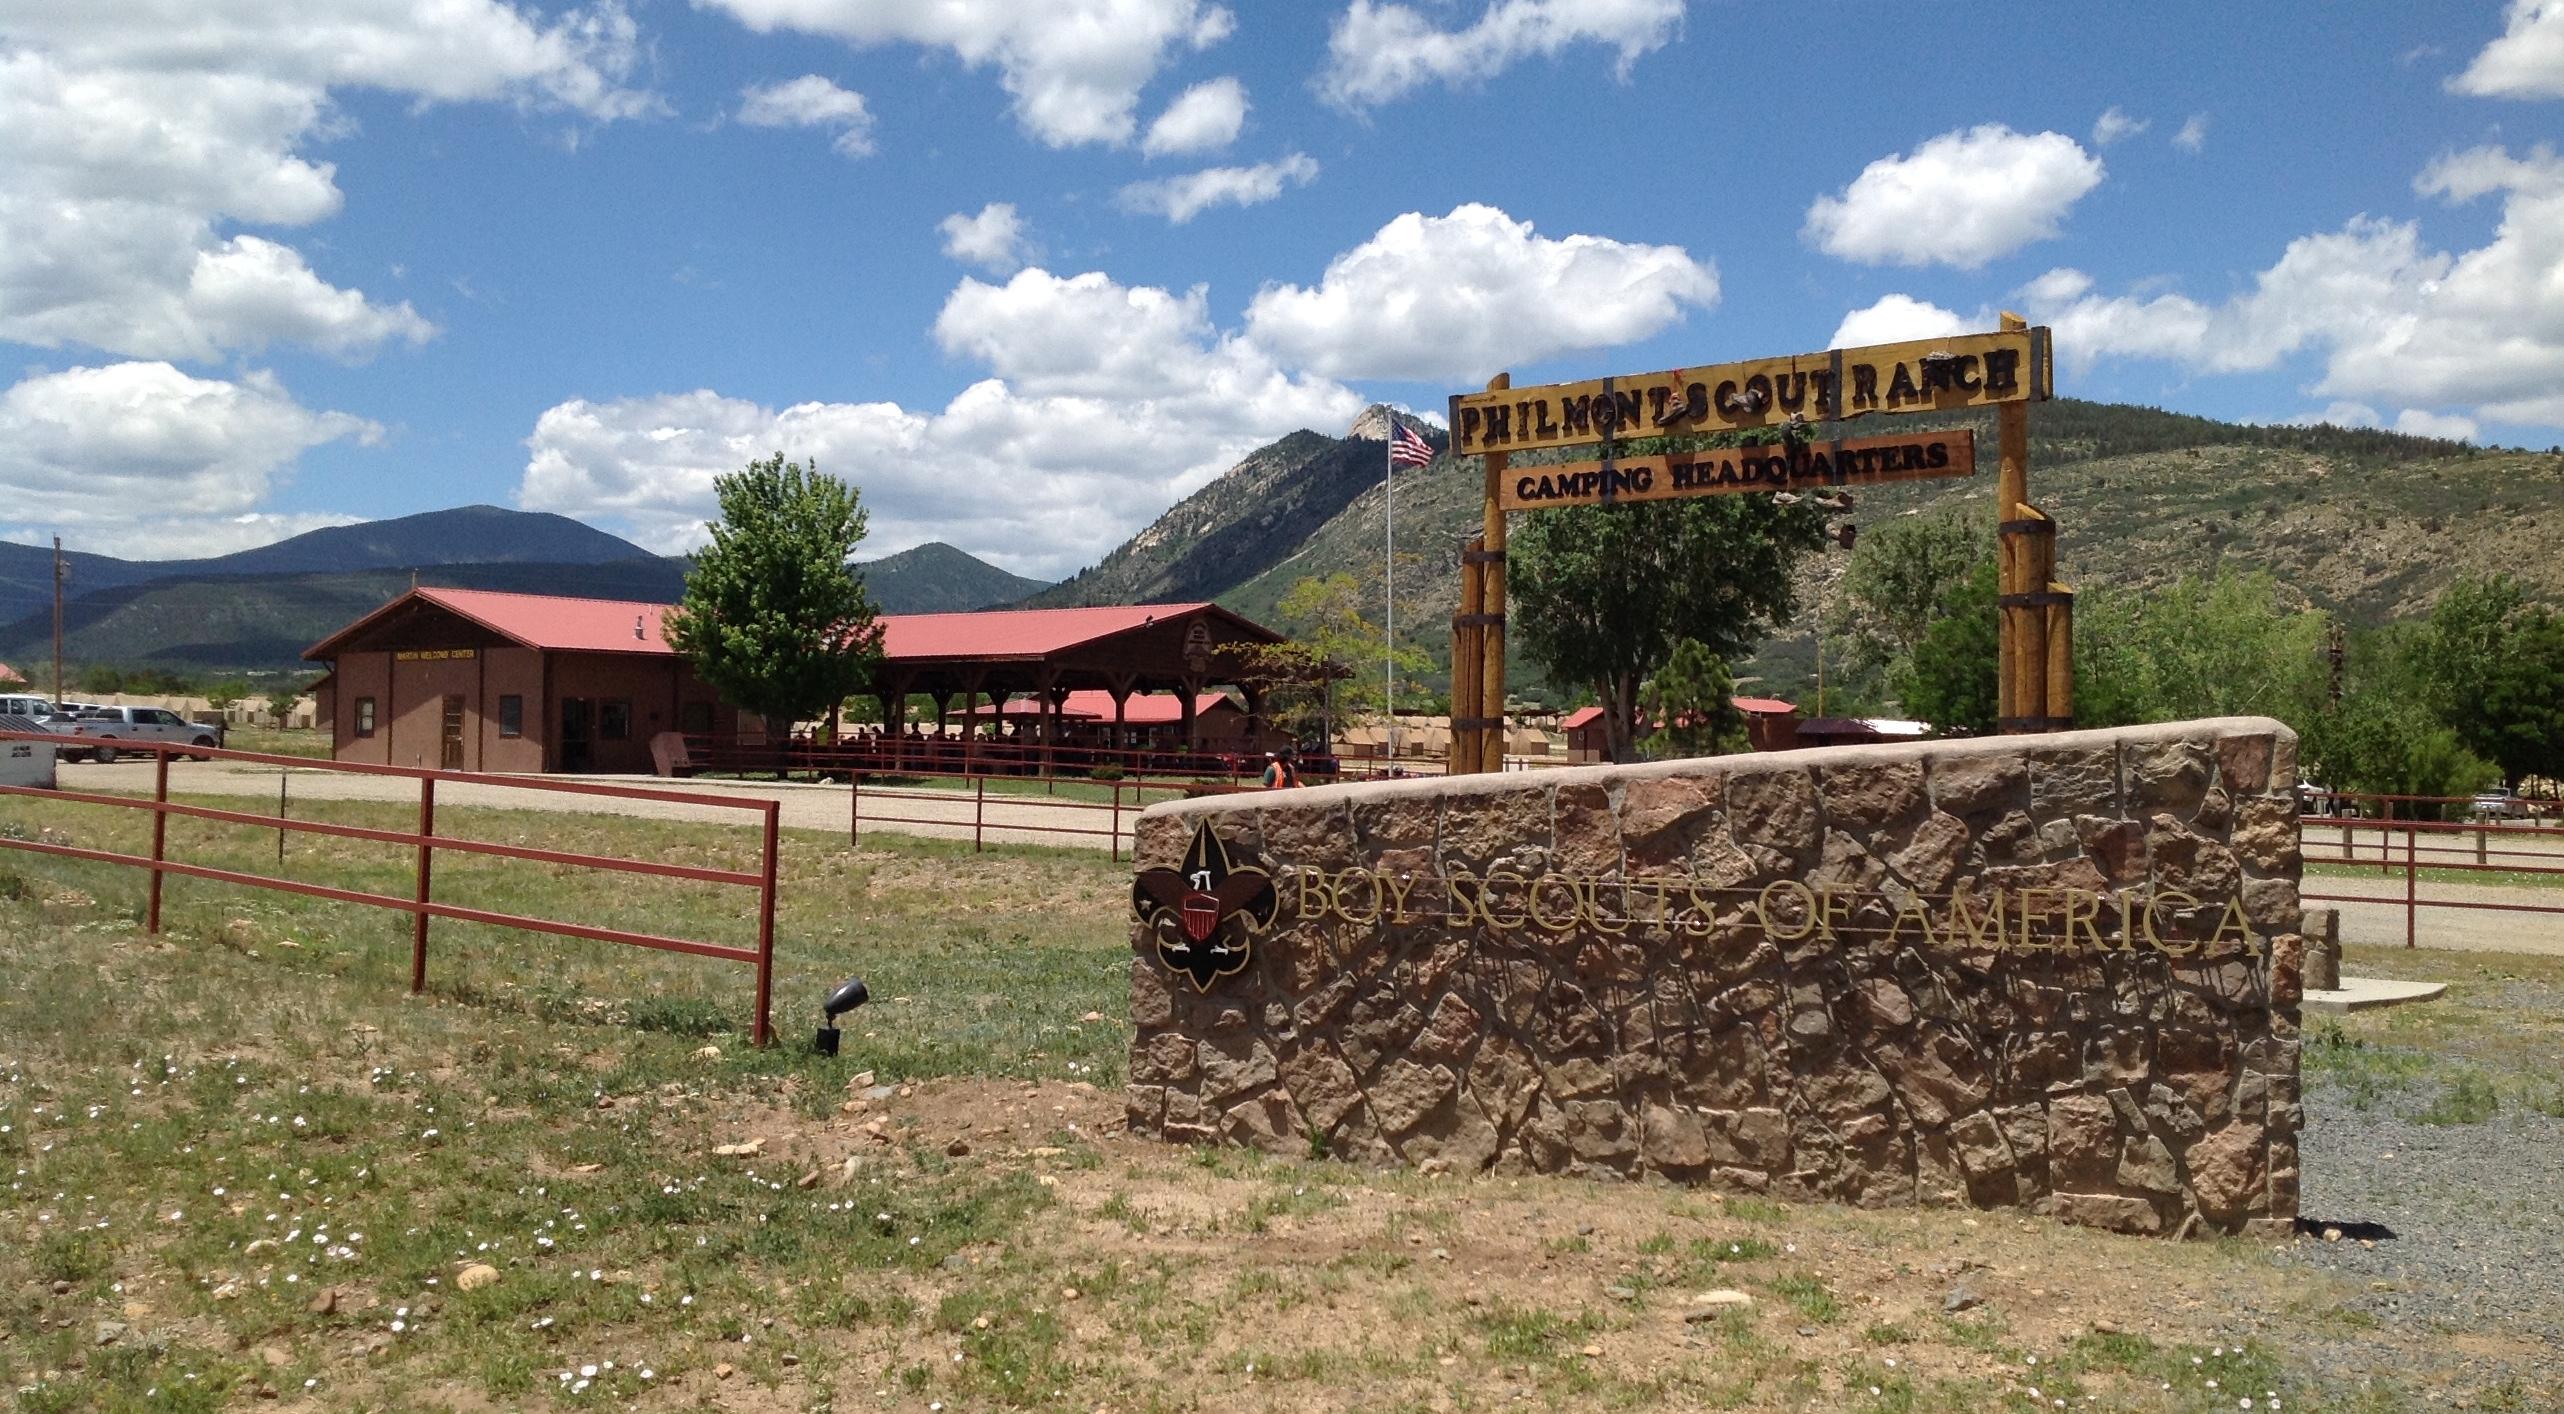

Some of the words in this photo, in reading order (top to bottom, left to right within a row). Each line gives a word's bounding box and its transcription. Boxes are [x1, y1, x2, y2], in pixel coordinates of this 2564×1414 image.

[1461, 386, 1671, 444] PHILMONT
[1686, 368, 1834, 420] SCOUT
[1852, 349, 2019, 402] RANCH
[1517, 465, 1653, 501] CAMPING
[1673, 442, 1948, 490] HEADQUARTERS
[452, 649, 475, 659] CENTER
[1296, 865, 1423, 924] BOY
[1447, 871, 1718, 937] SCOUTS
[1758, 879, 1855, 941] OF
[1888, 884, 2263, 957] AMERICA
